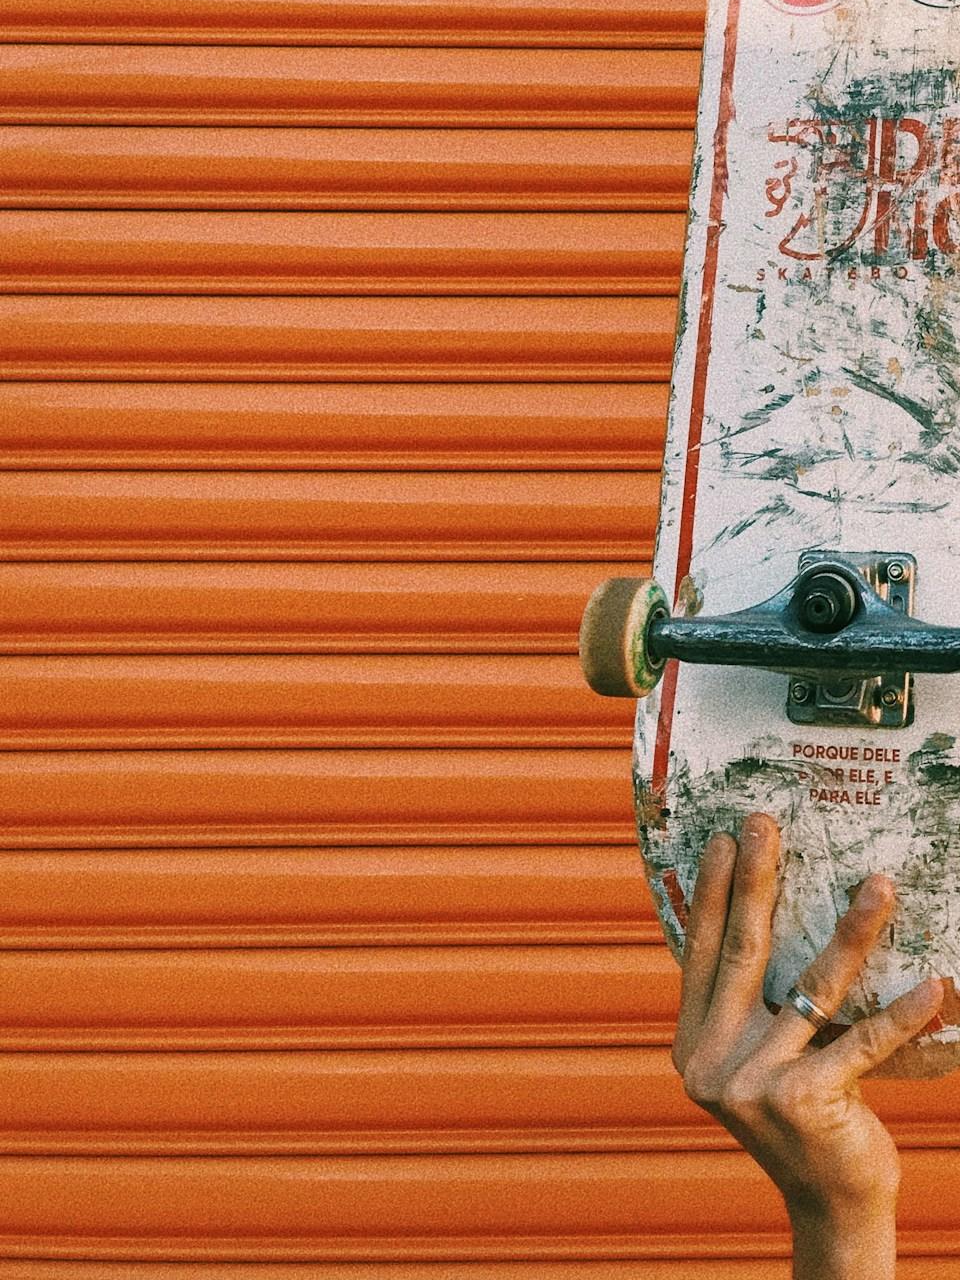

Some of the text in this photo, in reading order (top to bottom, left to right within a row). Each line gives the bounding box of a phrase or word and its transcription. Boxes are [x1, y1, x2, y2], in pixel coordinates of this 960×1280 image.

[792, 743, 901, 763] PORQUE DELE
[849, 768, 880, 786] ELE,
[884, 770, 893, 784] E
[809, 788, 881, 806] PARA ELE
